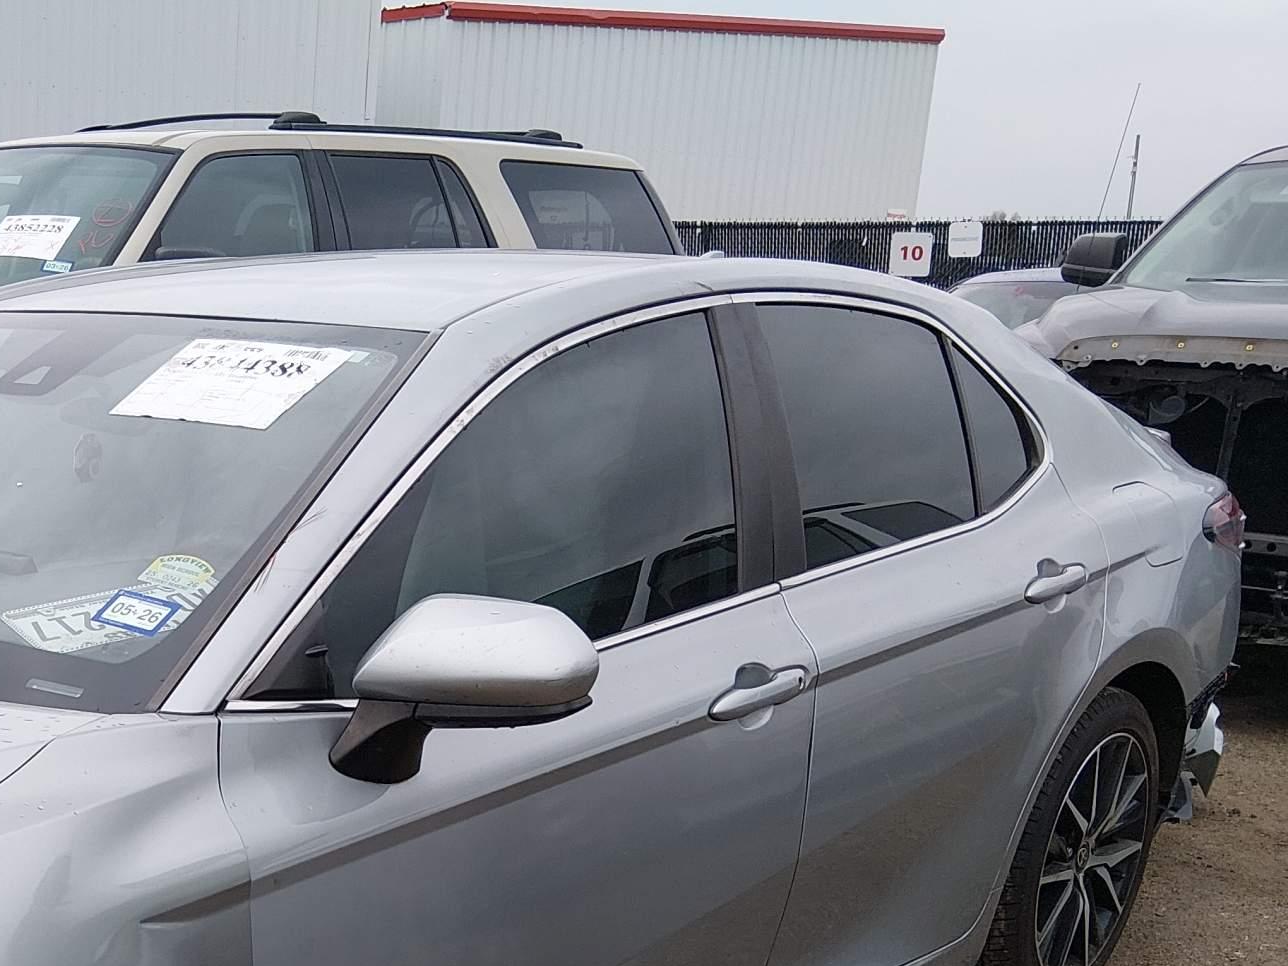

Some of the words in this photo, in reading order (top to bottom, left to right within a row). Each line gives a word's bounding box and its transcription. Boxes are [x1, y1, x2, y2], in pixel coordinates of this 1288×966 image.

[3, 223, 64, 233] 43852228
[900, 245, 924, 261] 10
[160, 556, 211, 574] LONGVIEW
